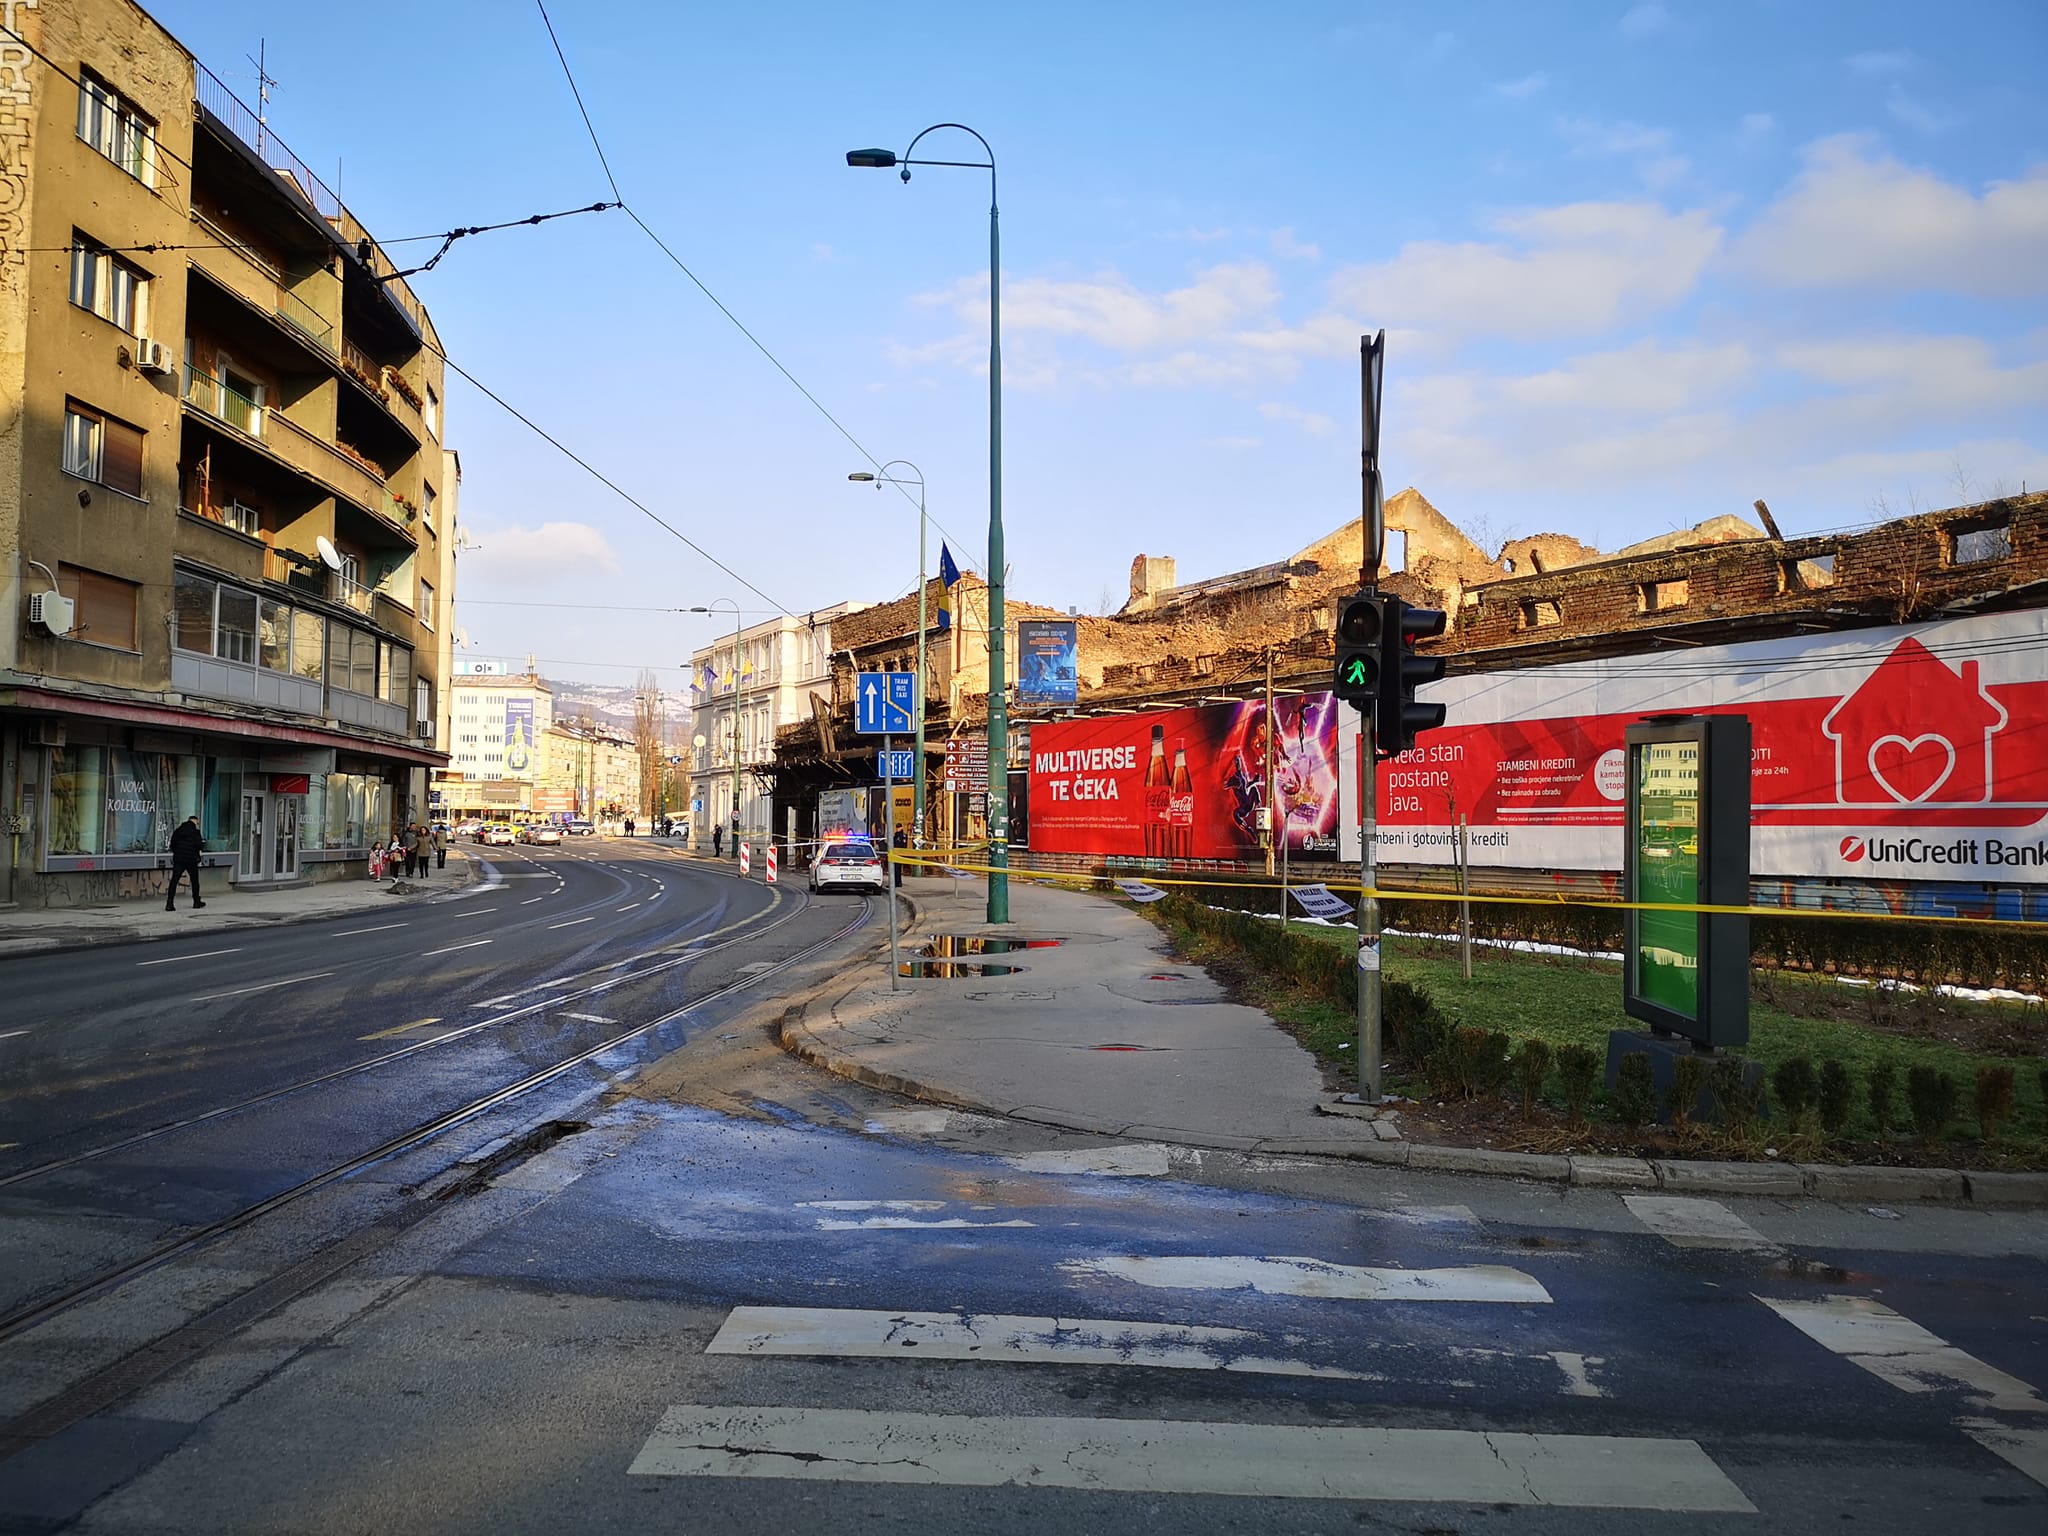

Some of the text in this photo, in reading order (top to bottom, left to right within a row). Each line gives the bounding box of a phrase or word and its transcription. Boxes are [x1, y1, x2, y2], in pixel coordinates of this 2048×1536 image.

[1035, 745, 1137, 774] MULTIVERSE
[1430, 744, 1464, 762] stan
[1496, 758, 1576, 772] STAMBENI KREDITI
[1774, 766, 1789, 775] 24h
[120, 780, 145, 793] NOVA
[1049, 773, 1119, 801] TE ČEKA
[1389, 769, 1449, 792] postane
[107, 799, 156, 815] KOLEKCIJA
[1388, 793, 1423, 816] java.
[1357, 832, 1404, 845] Smbeni
[1407, 832, 1410, 845] i
[1471, 832, 1509, 846] krediti
[1869, 838, 2048, 866] UniCredit Bank
